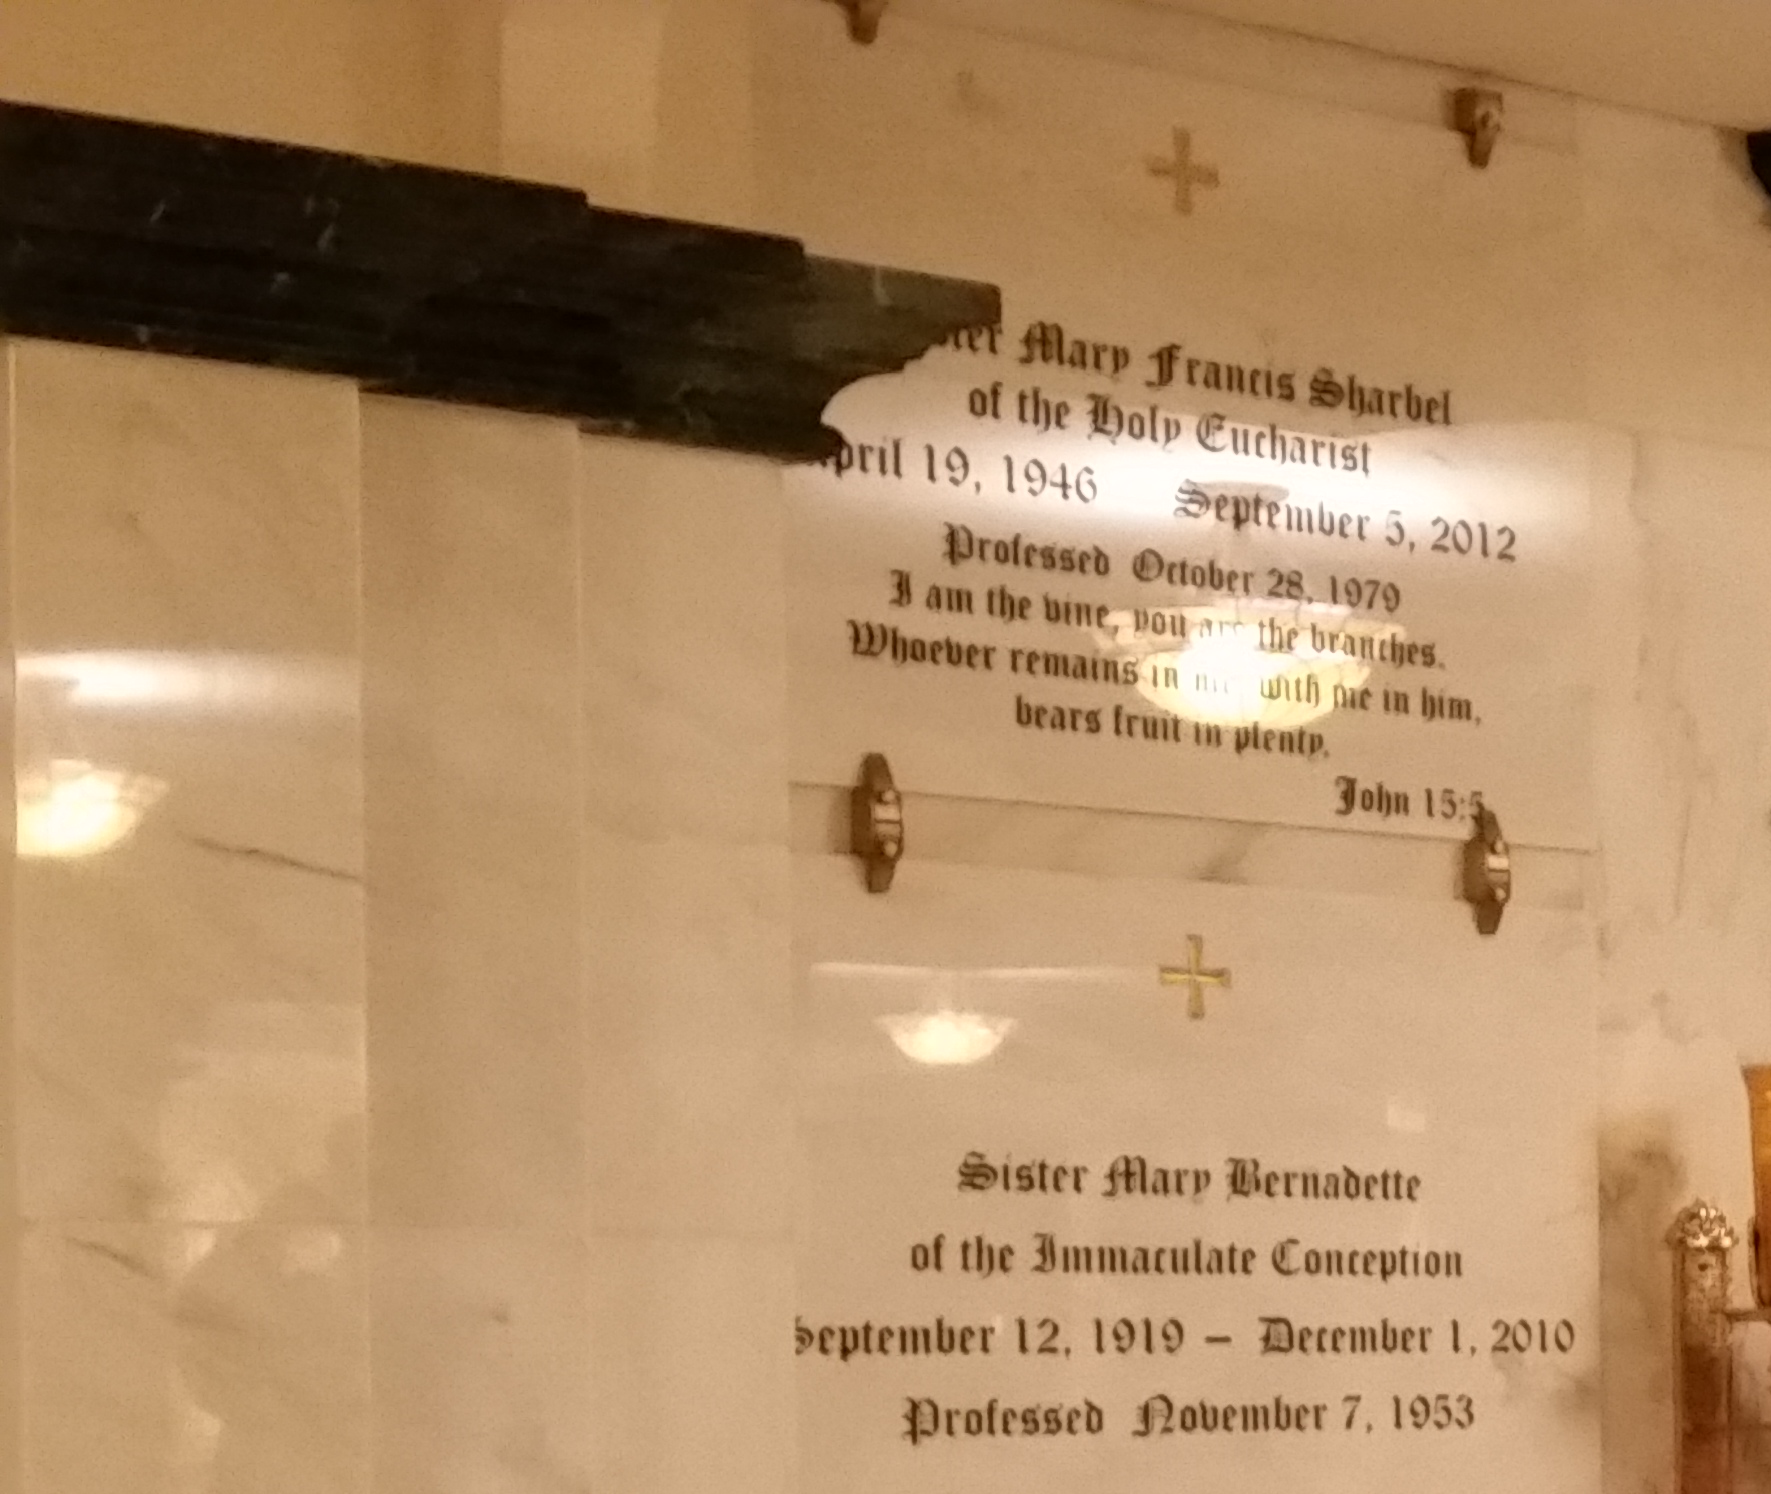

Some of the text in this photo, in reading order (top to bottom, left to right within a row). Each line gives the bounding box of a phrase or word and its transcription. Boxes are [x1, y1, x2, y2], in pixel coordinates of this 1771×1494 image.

[1018, 320, 1131, 377] Mary
[1145, 343, 1296, 403] Francis
[1308, 367, 1454, 427] Sharbel
[968, 381, 1371, 477] of the Holy Eucharist
[828, 438, 1516, 562] pril 19, 1946 September 5, 2012
[943, 521, 1110, 577] Professed
[1132, 547, 1255, 596] October
[1330, 574, 1401, 612] 1979
[889, 569, 912, 607] I
[926, 583, 974, 614] am
[986, 584, 1032, 622] the
[1043, 593, 1120, 638] vine,
[1133, 607, 1187, 638] you
[1258, 617, 1299, 652] the
[1310, 622, 1446, 669] branches.
[847, 619, 997, 670] Whoever
[1010, 647, 1140, 686] remains
[1151, 664, 1178, 690] in
[1260, 673, 1320, 707] with
[1333, 683, 1372, 710] me
[1382, 688, 1410, 715] in
[1421, 687, 1482, 726] him,
[1014, 694, 1101, 734] bears
[1113, 703, 1182, 743] fruit
[1194, 720, 1222, 747] in
[1335, 775, 1409, 817] John
[957, 1151, 1422, 1203] Sister Mary Bernadette
[910, 1232, 1463, 1283] of the Immaculate Conception
[1015, 1315, 1072, 1359] 12,
[1093, 1316, 1185, 1357] 1919
[1258, 1315, 1434, 1357] December
[1451, 1318, 1477, 1358] 1,
[1491, 1318, 1575, 1354] 2010
[902, 1396, 1104, 1446] Professed
[1131, 1393, 1328, 1439] November
[1392, 1393, 1475, 1432] 1953
